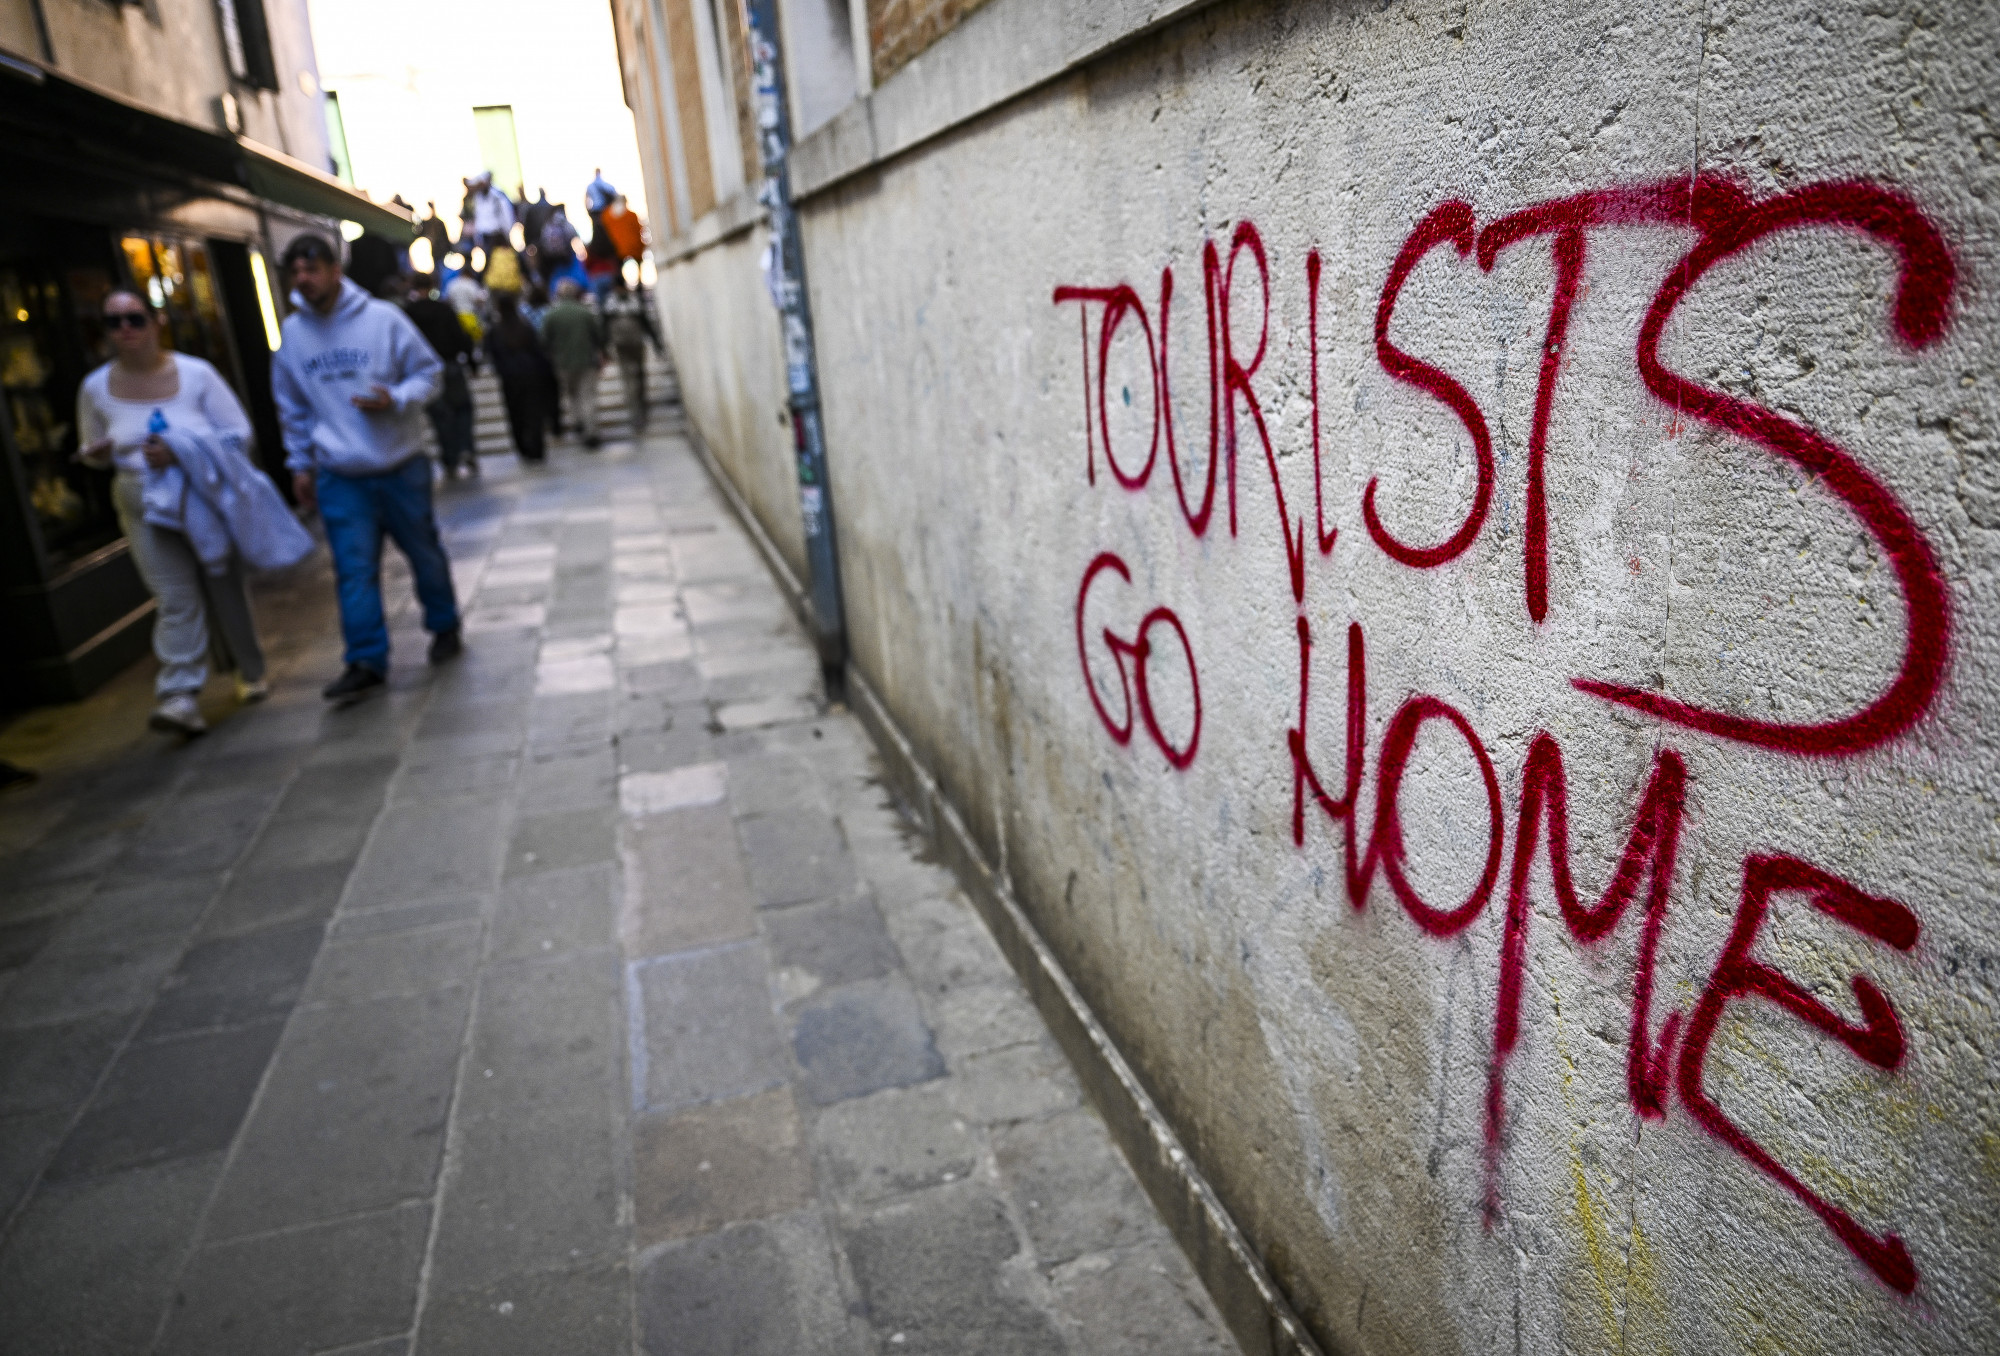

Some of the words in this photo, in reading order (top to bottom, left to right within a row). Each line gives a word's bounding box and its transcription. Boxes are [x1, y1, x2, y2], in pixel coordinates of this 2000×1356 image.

[1053, 170, 1957, 758] TOURISTS
[1077, 552, 1202, 769] GO
[1288, 615, 1920, 1296] HOME
